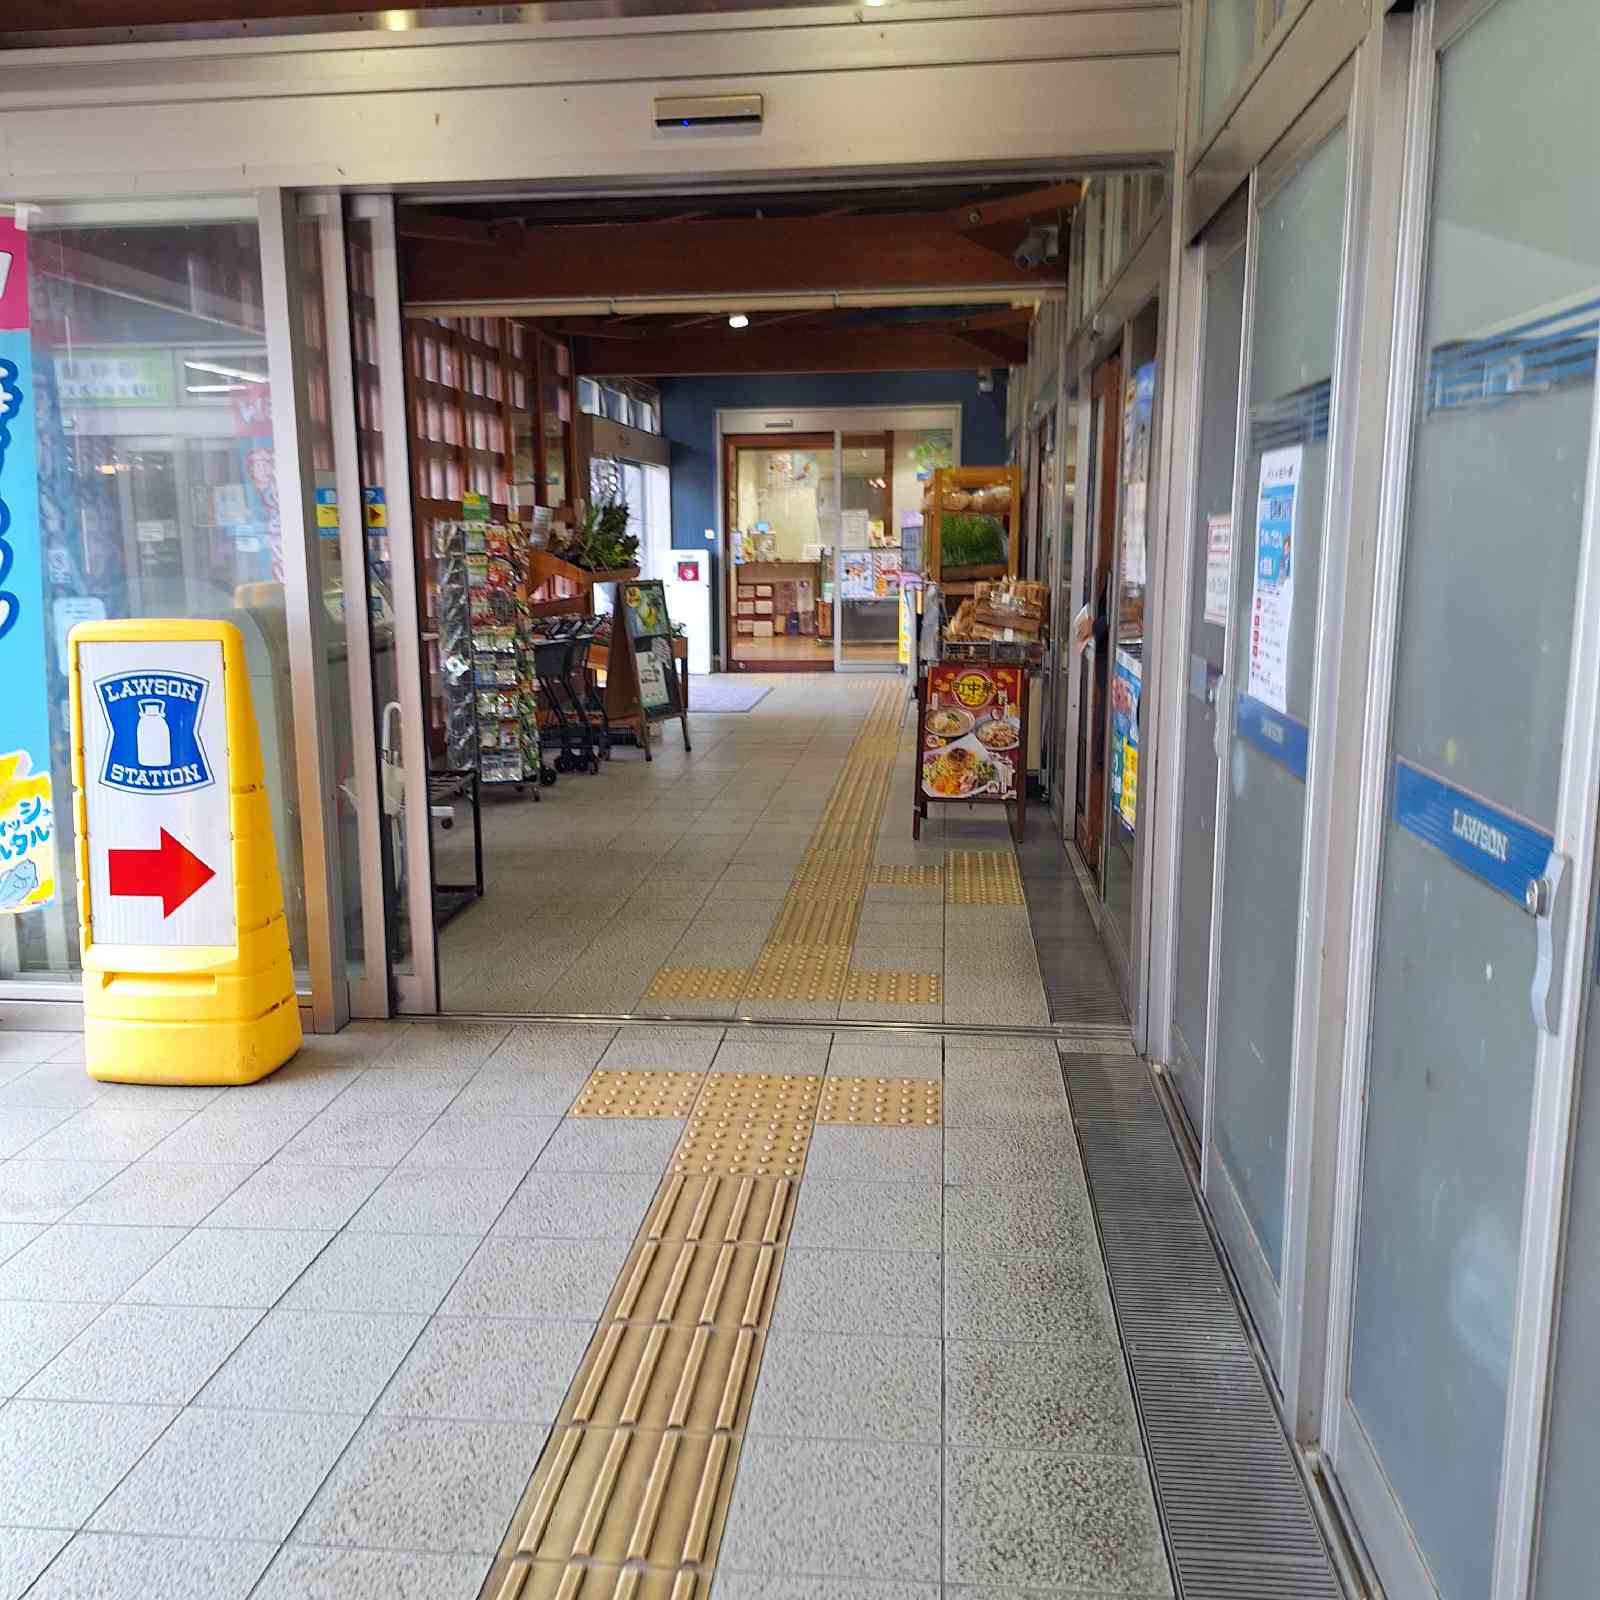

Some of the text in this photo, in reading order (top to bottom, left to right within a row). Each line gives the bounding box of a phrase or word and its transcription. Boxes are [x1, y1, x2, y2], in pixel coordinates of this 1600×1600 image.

[105, 679, 199, 702] LAWSON
[111, 764, 202, 786] STATION
[1452, 808, 1508, 861] LAWSON
